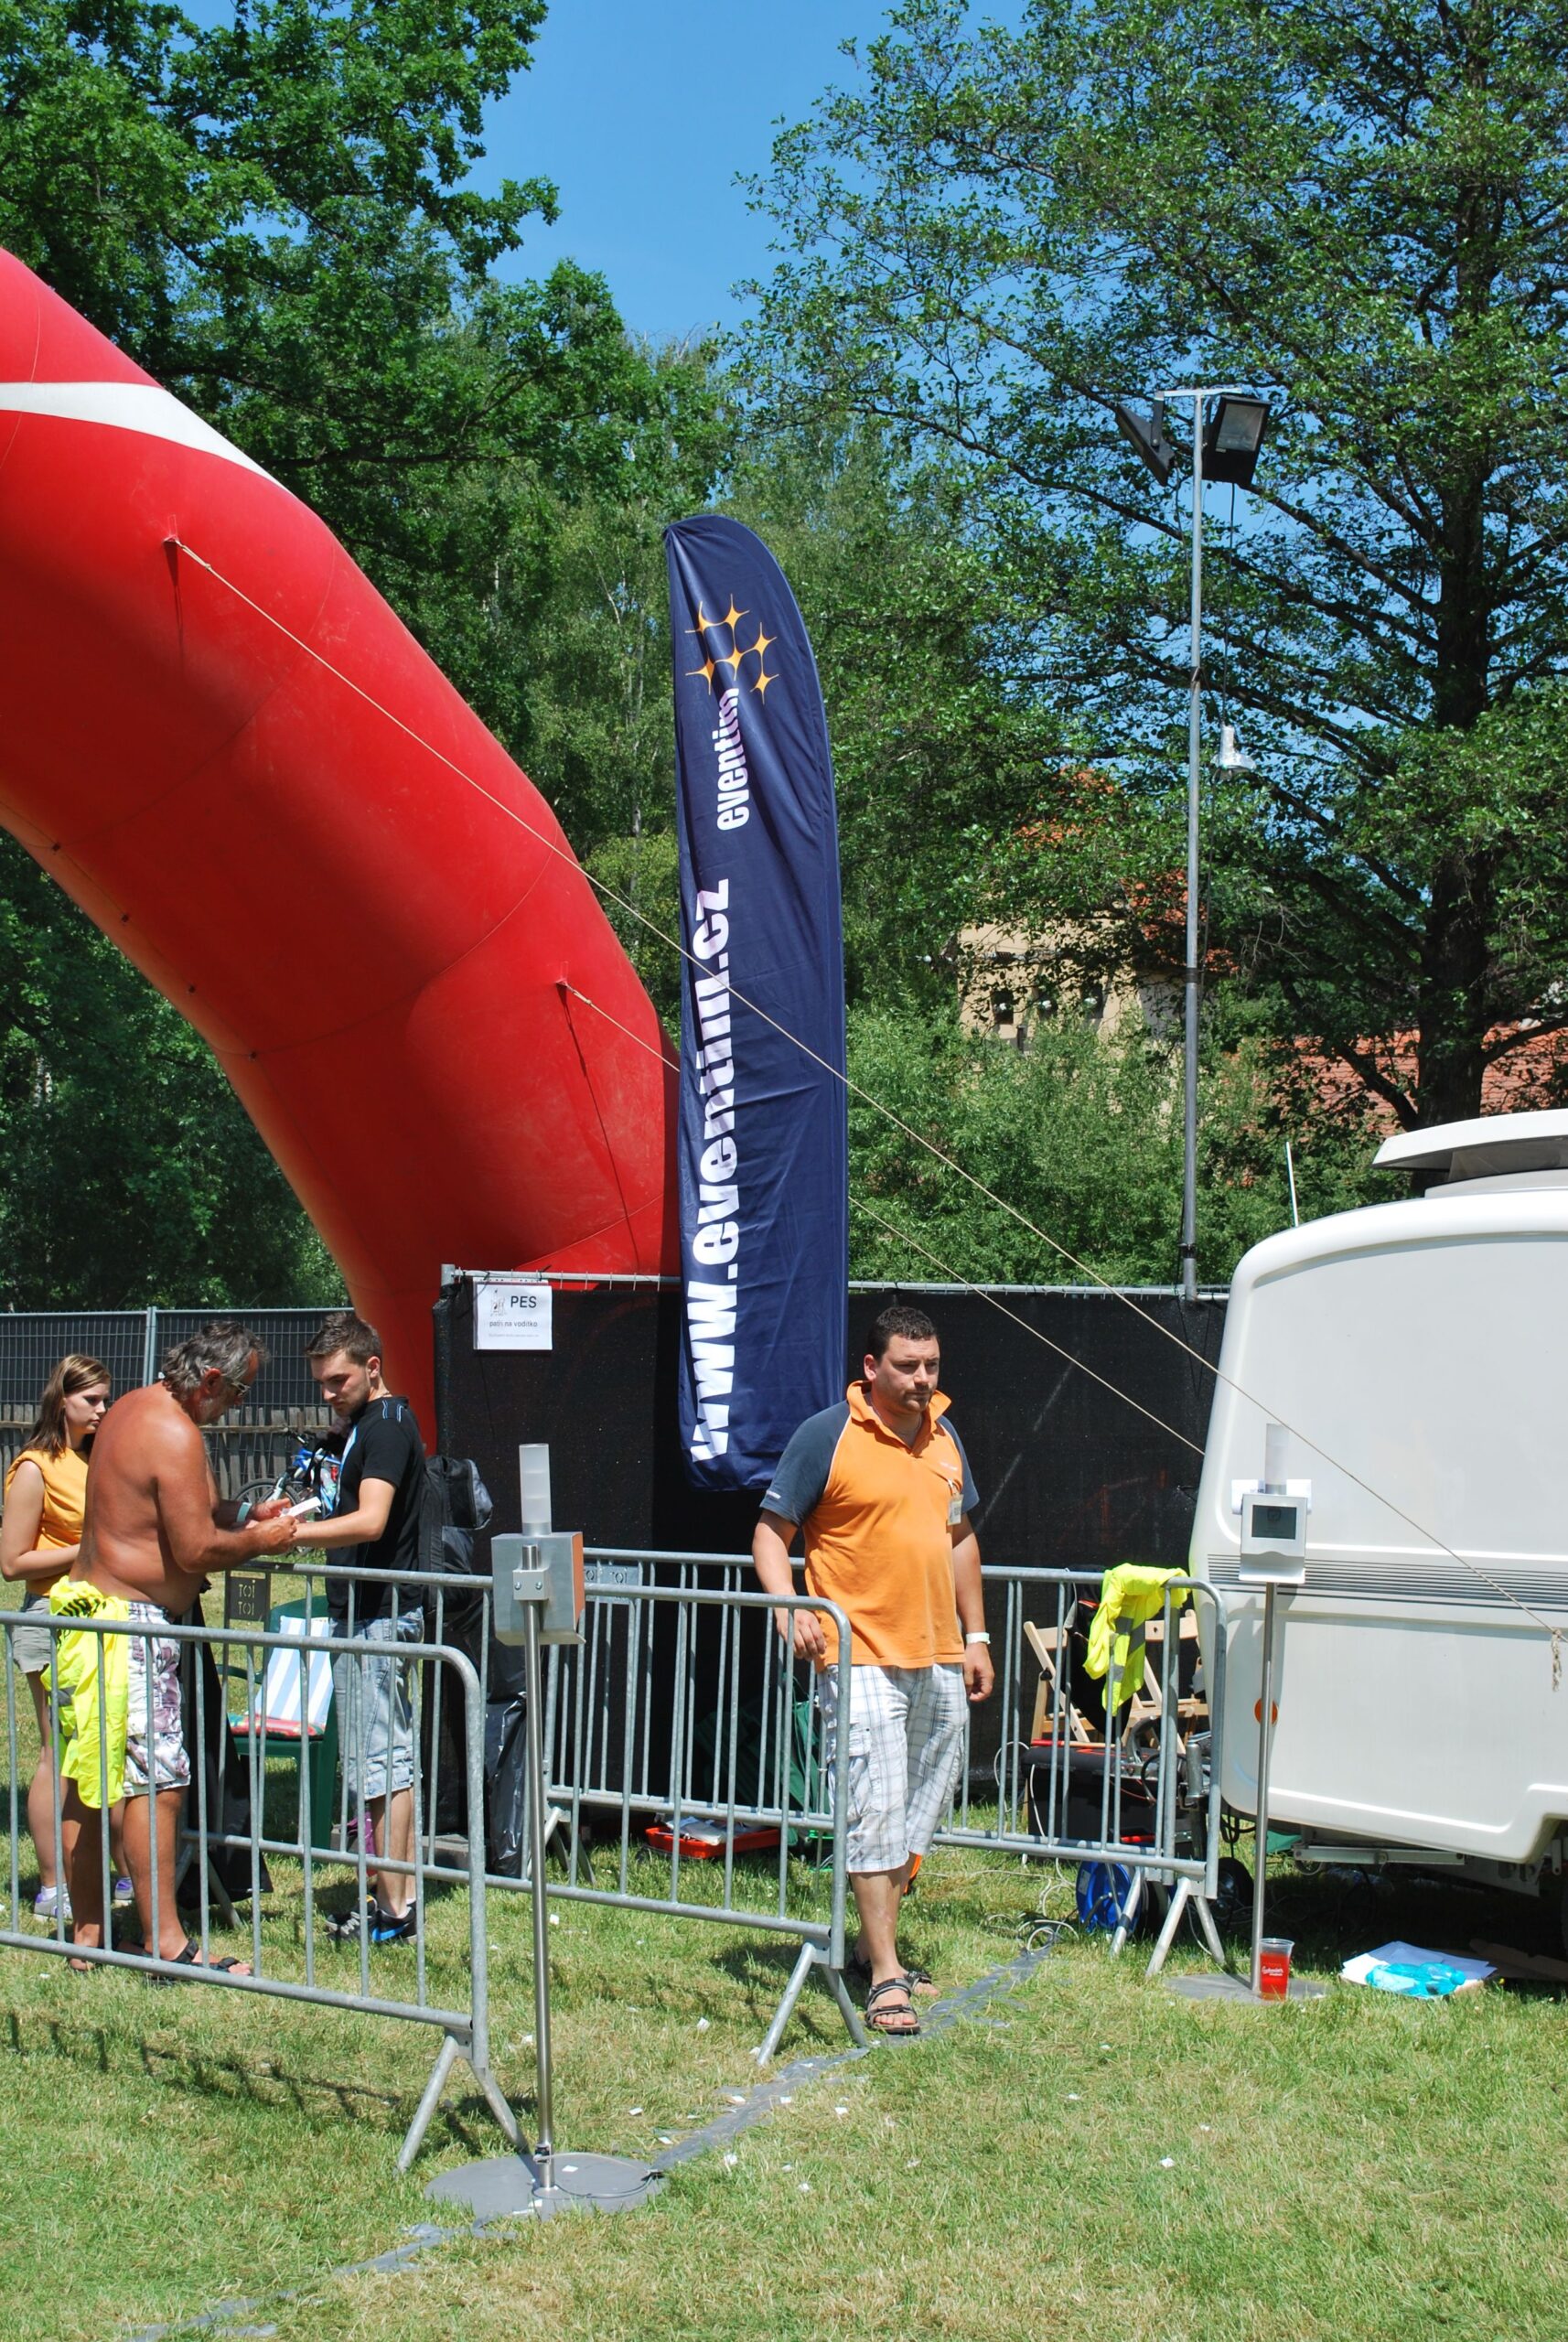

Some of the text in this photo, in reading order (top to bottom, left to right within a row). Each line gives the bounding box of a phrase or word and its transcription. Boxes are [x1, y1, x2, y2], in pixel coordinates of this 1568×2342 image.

[712, 687, 750, 831] eventim
[687, 878, 740, 1463] www.eventim.cz
[510, 1295, 537, 1308] PES
